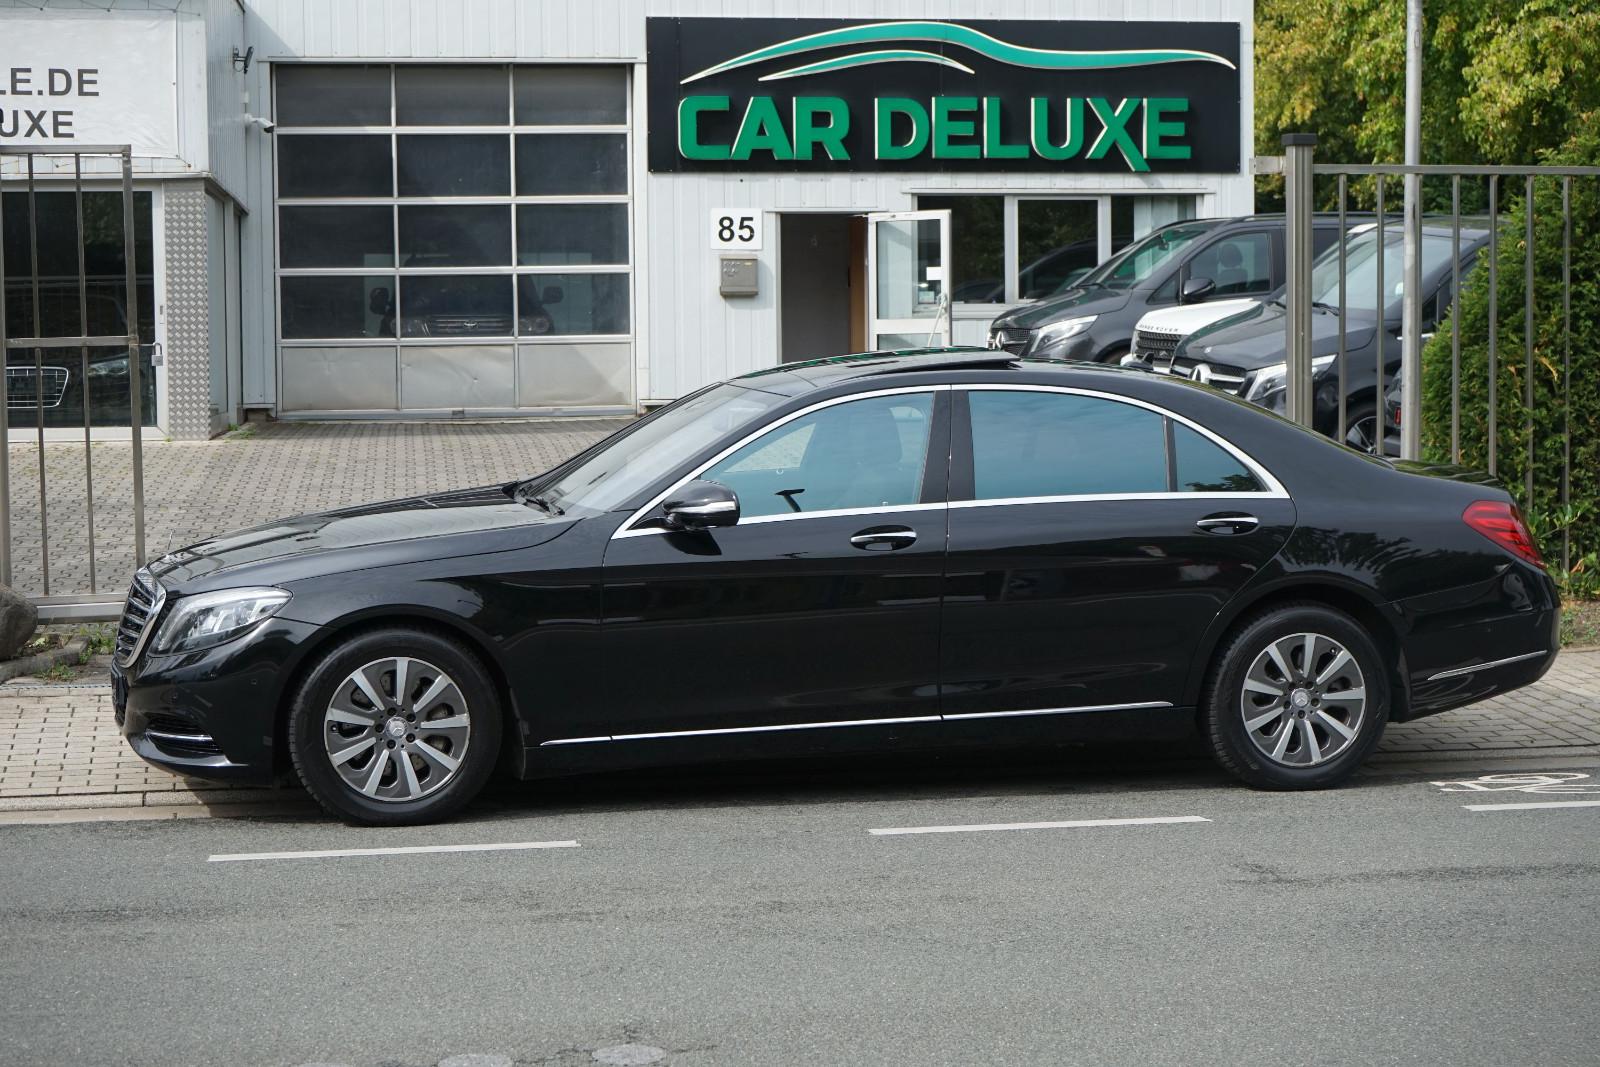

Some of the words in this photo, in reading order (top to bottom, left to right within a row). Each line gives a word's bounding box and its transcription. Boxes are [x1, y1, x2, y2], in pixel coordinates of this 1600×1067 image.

[678, 96, 851, 160] CAR
[875, 97, 1191, 172] DELUXE
[718, 216, 755, 242] 85
